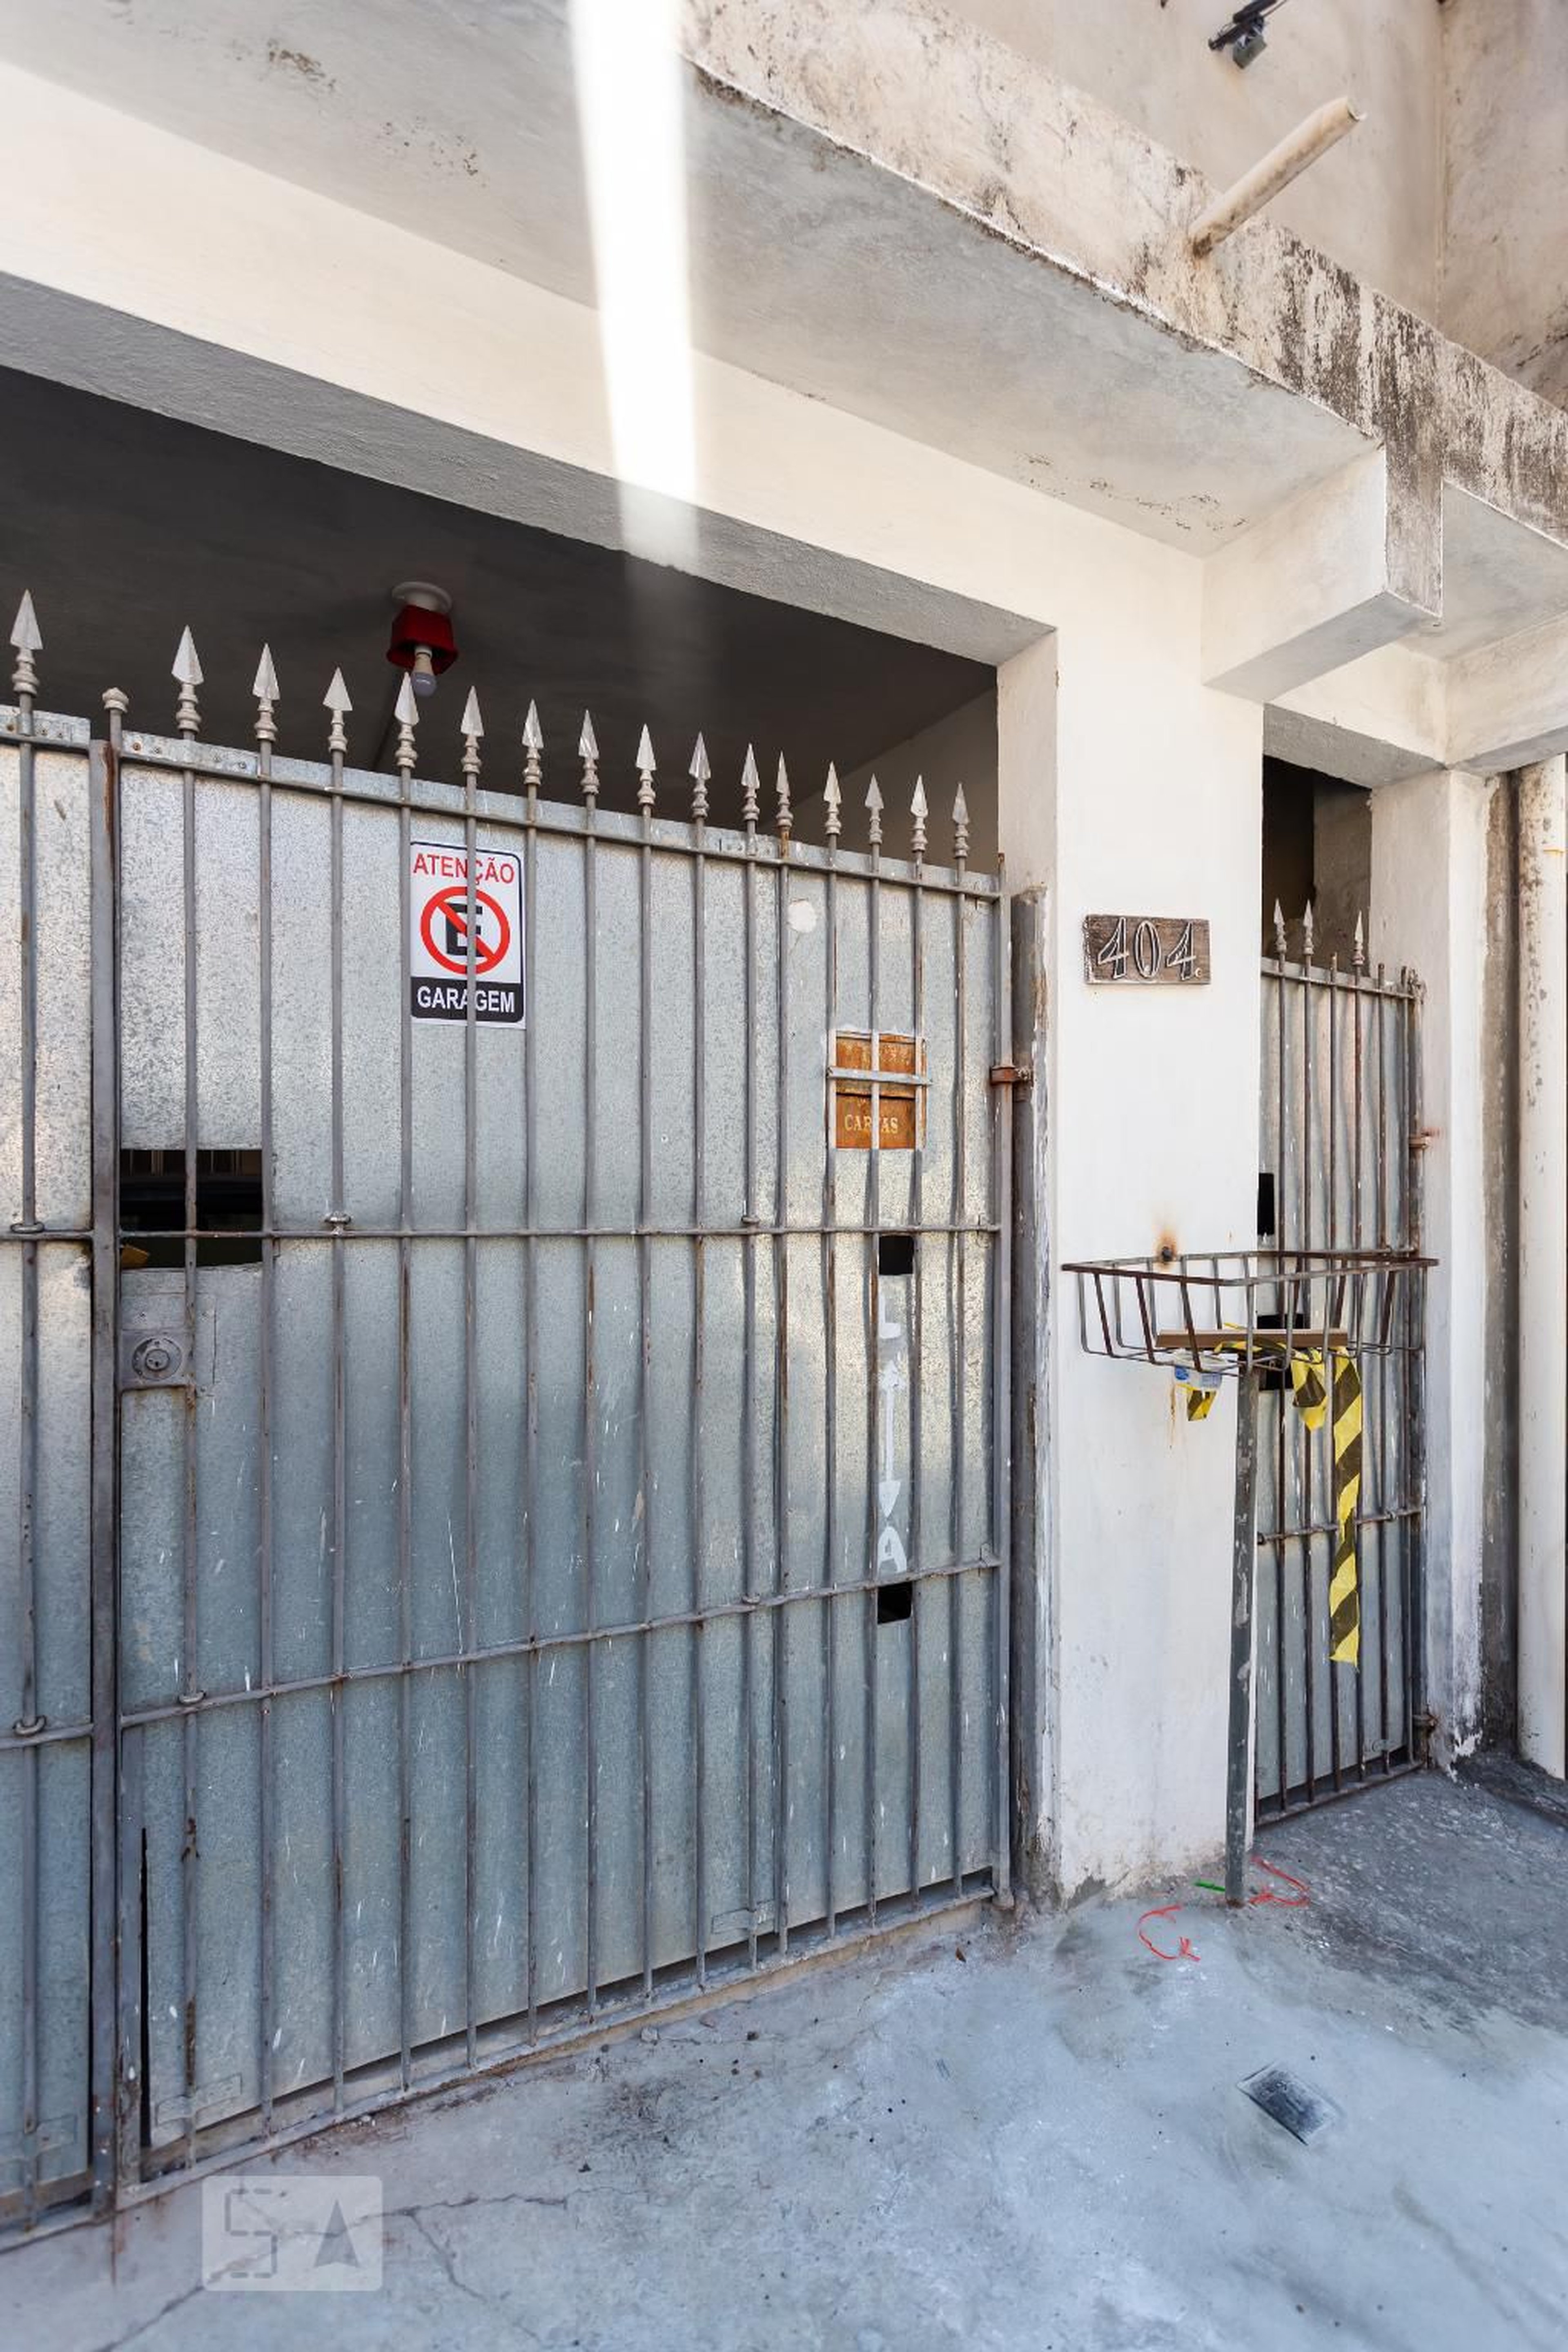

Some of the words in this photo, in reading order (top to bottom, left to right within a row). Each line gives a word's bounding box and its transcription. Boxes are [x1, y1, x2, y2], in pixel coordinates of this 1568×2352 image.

[1098, 917, 1196, 980] 404
[417, 986, 514, 1013] GARAGEM
[844, 1114, 898, 1134] CARAS
